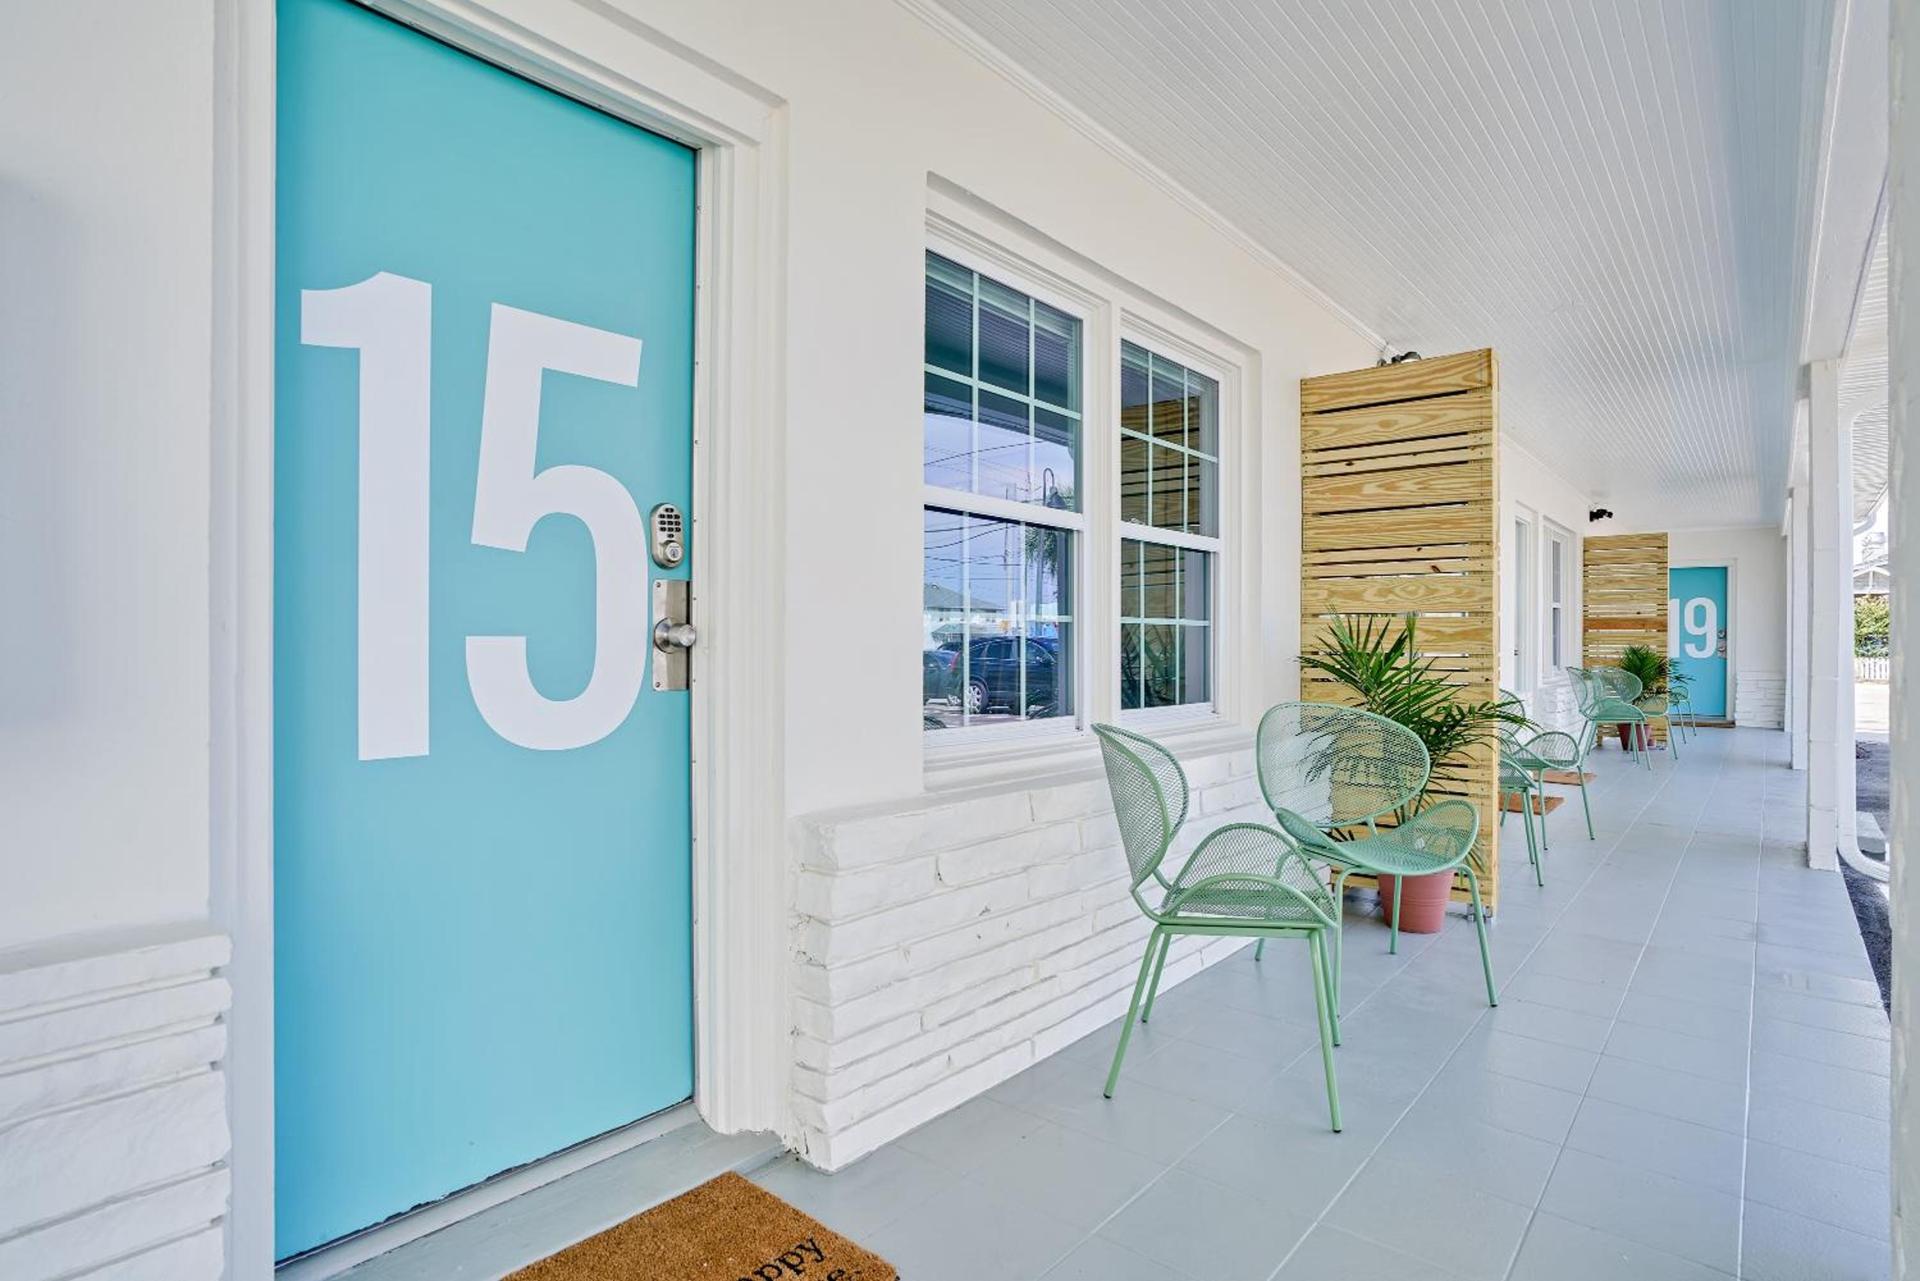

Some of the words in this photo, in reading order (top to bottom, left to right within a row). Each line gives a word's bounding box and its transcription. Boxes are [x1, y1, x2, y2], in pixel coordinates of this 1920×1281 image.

[301, 271, 648, 761] 15
[1668, 597, 1717, 659] 19
[738, 1237, 826, 1281] ppy
